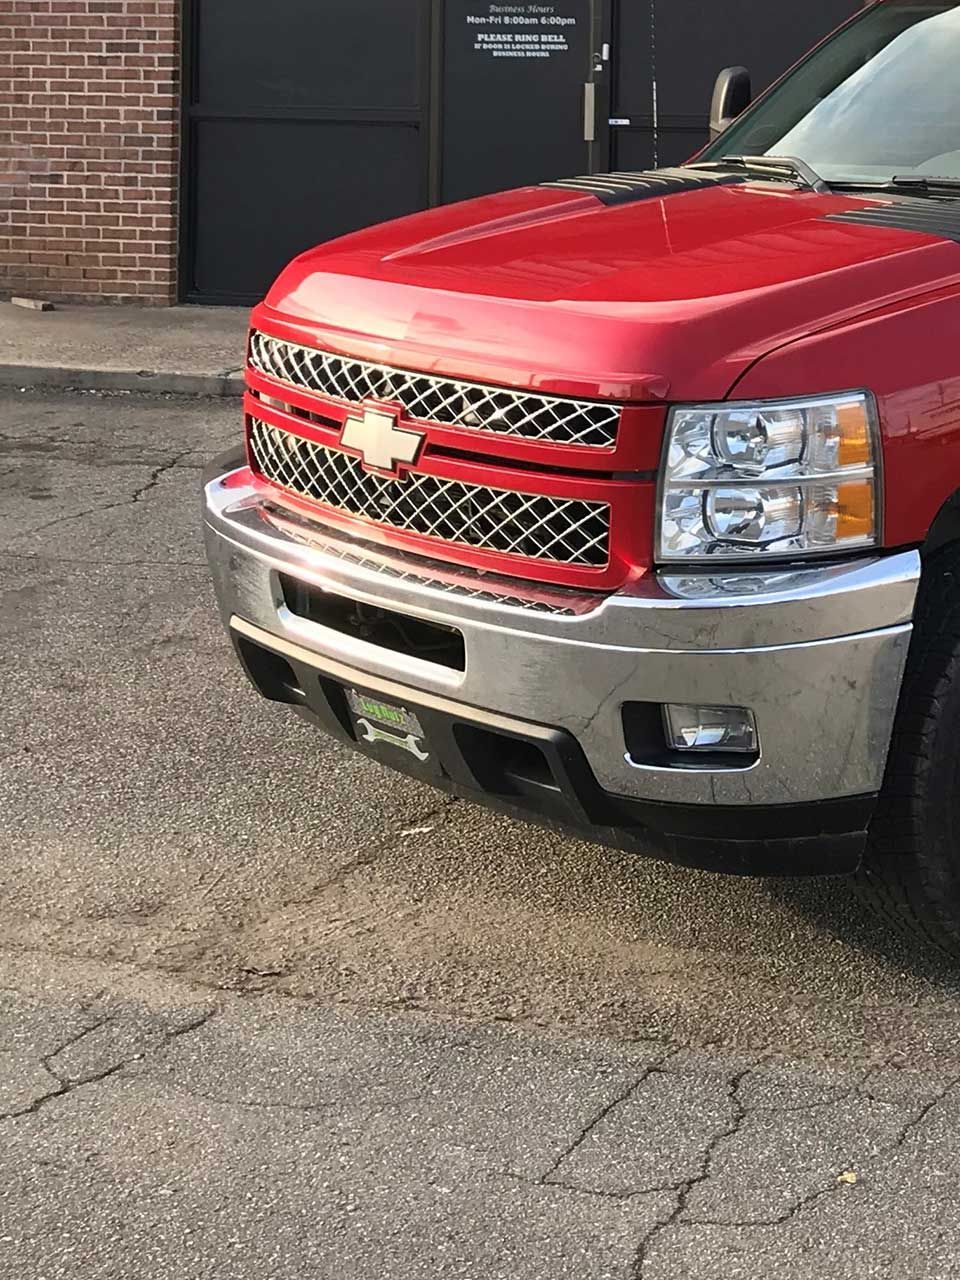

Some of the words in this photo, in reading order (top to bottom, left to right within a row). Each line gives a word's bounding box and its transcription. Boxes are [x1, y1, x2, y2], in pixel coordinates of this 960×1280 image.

[488, 4, 525, 14] Business
[526, 4, 555, 14] Hours
[466, 16, 502, 25] Mon-Fri
[503, 16, 539, 25] 8:00am
[540, 16, 576, 26] 6:00pm
[477, 33, 514, 42] PLEASE
[514, 33, 540, 42] RING
[541, 34, 566, 42] BELL
